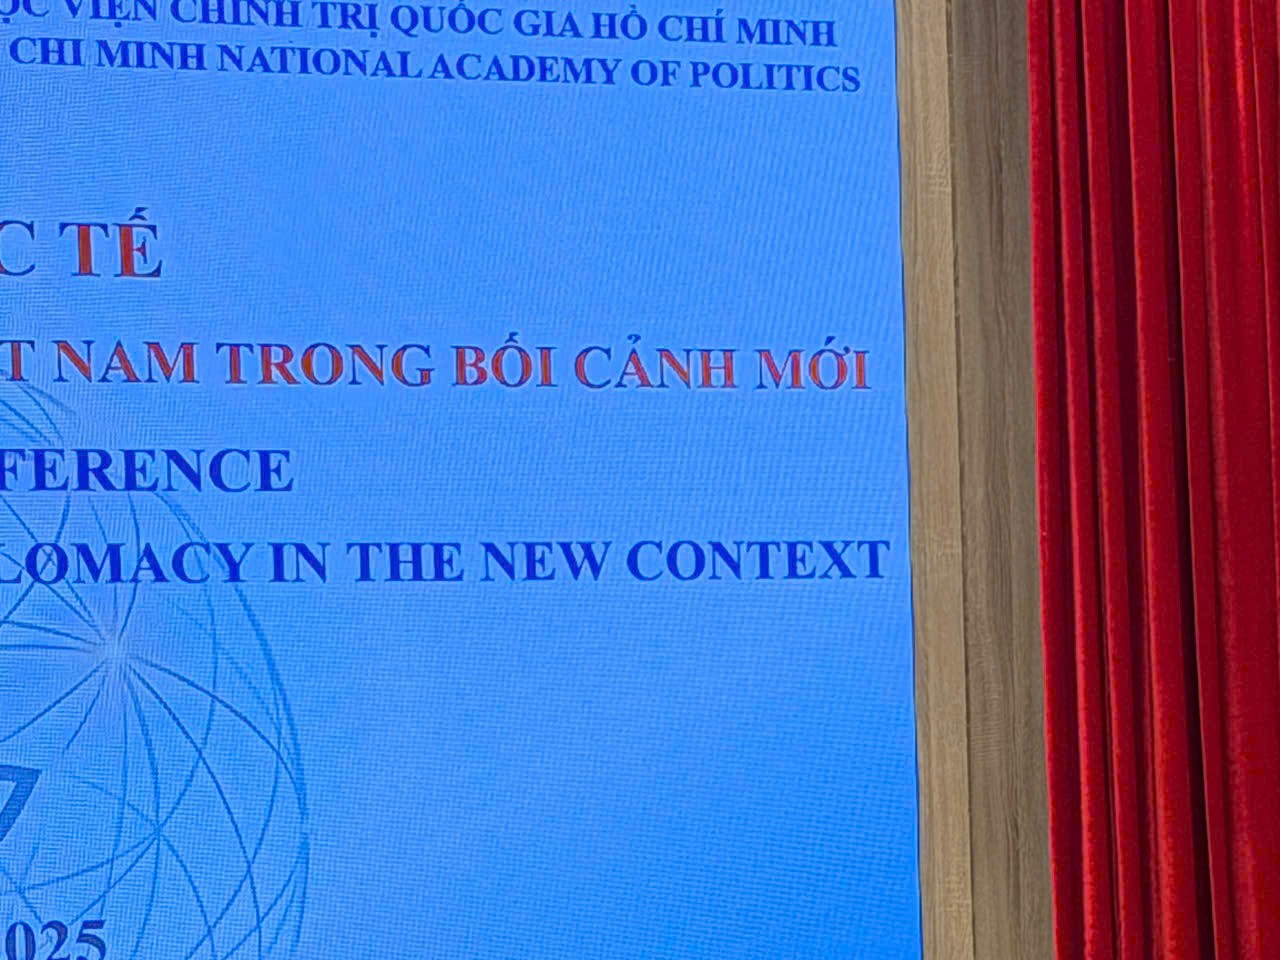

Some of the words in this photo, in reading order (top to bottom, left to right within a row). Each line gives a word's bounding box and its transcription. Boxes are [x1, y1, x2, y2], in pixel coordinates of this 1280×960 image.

[312, 1, 381, 39] TRỊ
[513, 9, 584, 39] GIA
[591, 4, 648, 40] HỒ
[658, 9, 726, 43] CHÍ
[736, 18, 837, 47] MINH
[9, 36, 84, 66] CHI
[96, 39, 208, 71] MINH
[216, 44, 422, 78] NATIONAL
[428, 53, 622, 84] ACADEMY
[630, 59, 681, 87] OF
[689, 60, 861, 93] POLITICS
[59, 206, 163, 278] TẾ
[51, 340, 199, 384] NAM
[215, 342, 435, 388] TRONG
[450, 332, 558, 388] BỐI
[574, 334, 739, 390] CẢNH
[755, 336, 873, 390] MỚI
[267, 542, 331, 584] IN
[346, 542, 464, 583] THE
[480, 541, 613, 582] NEW
[626, 541, 891, 581] CONTEXT
